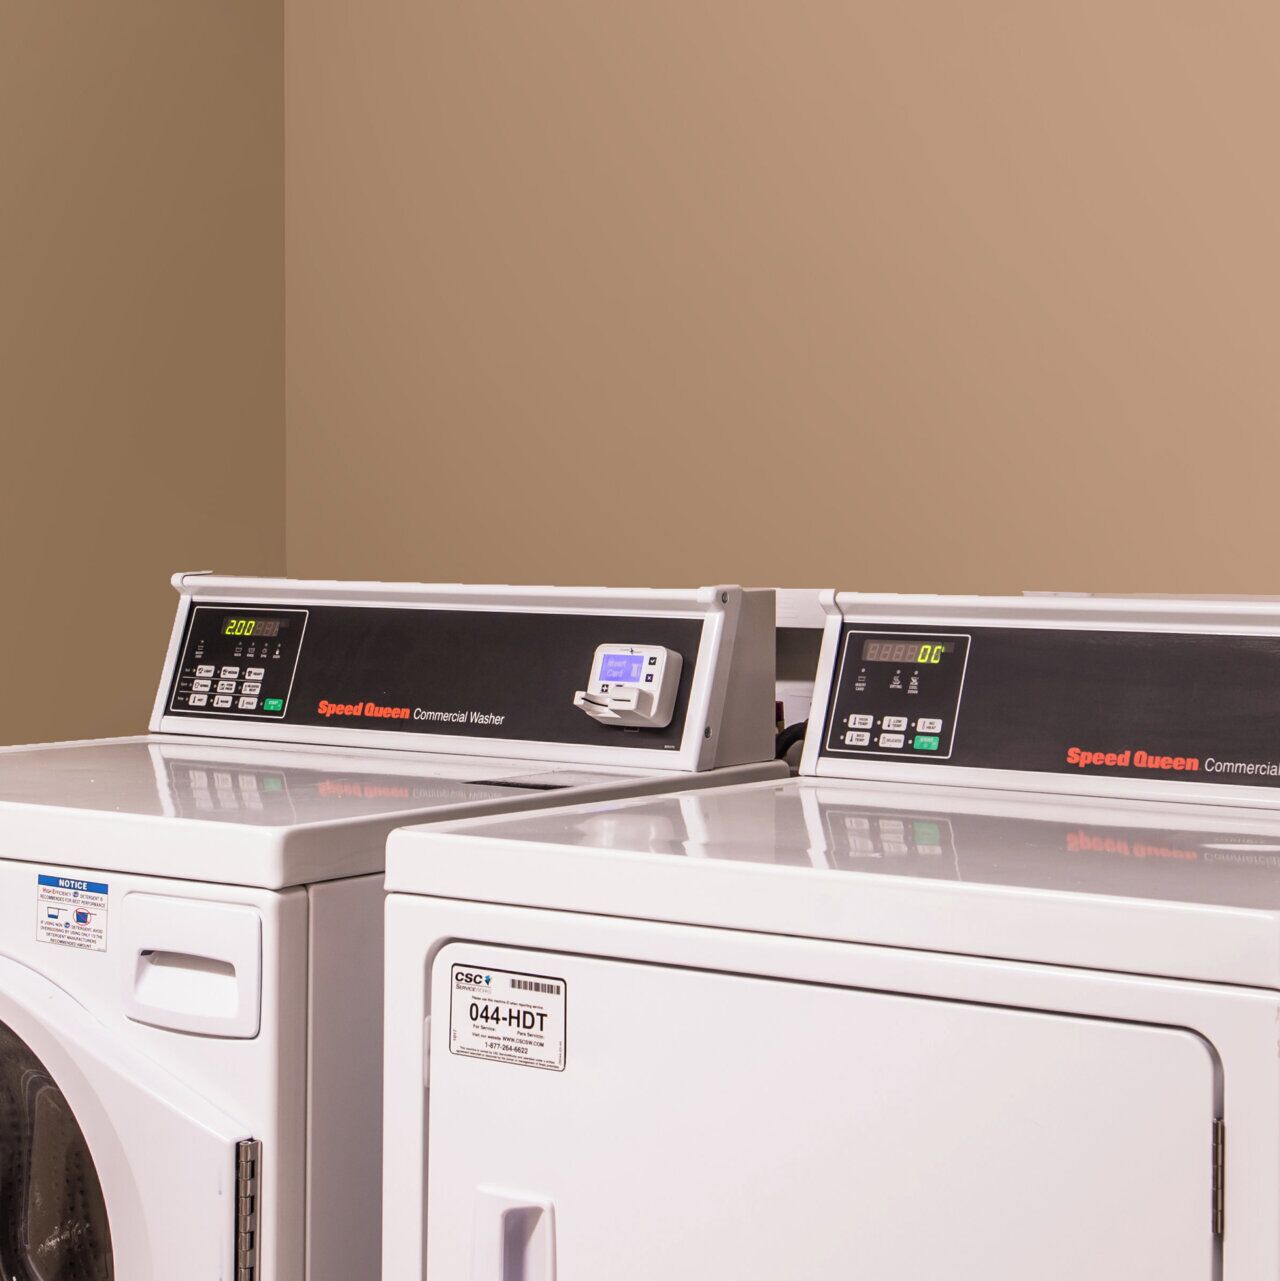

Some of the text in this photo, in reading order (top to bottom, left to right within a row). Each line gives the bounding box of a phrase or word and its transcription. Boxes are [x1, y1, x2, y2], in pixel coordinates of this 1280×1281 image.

[317, 700, 504, 725] Speed Queen Commercial Washer
[1066, 747, 1131, 768] Speed
[1133, 750, 1199, 771] Queen
[59, 879, 87, 890] NOTICE
[455, 972, 483, 984] CSC
[469, 1003, 548, 1031] 044-HDT
[485, 1042, 528, 1054] 1-877-264-6622
